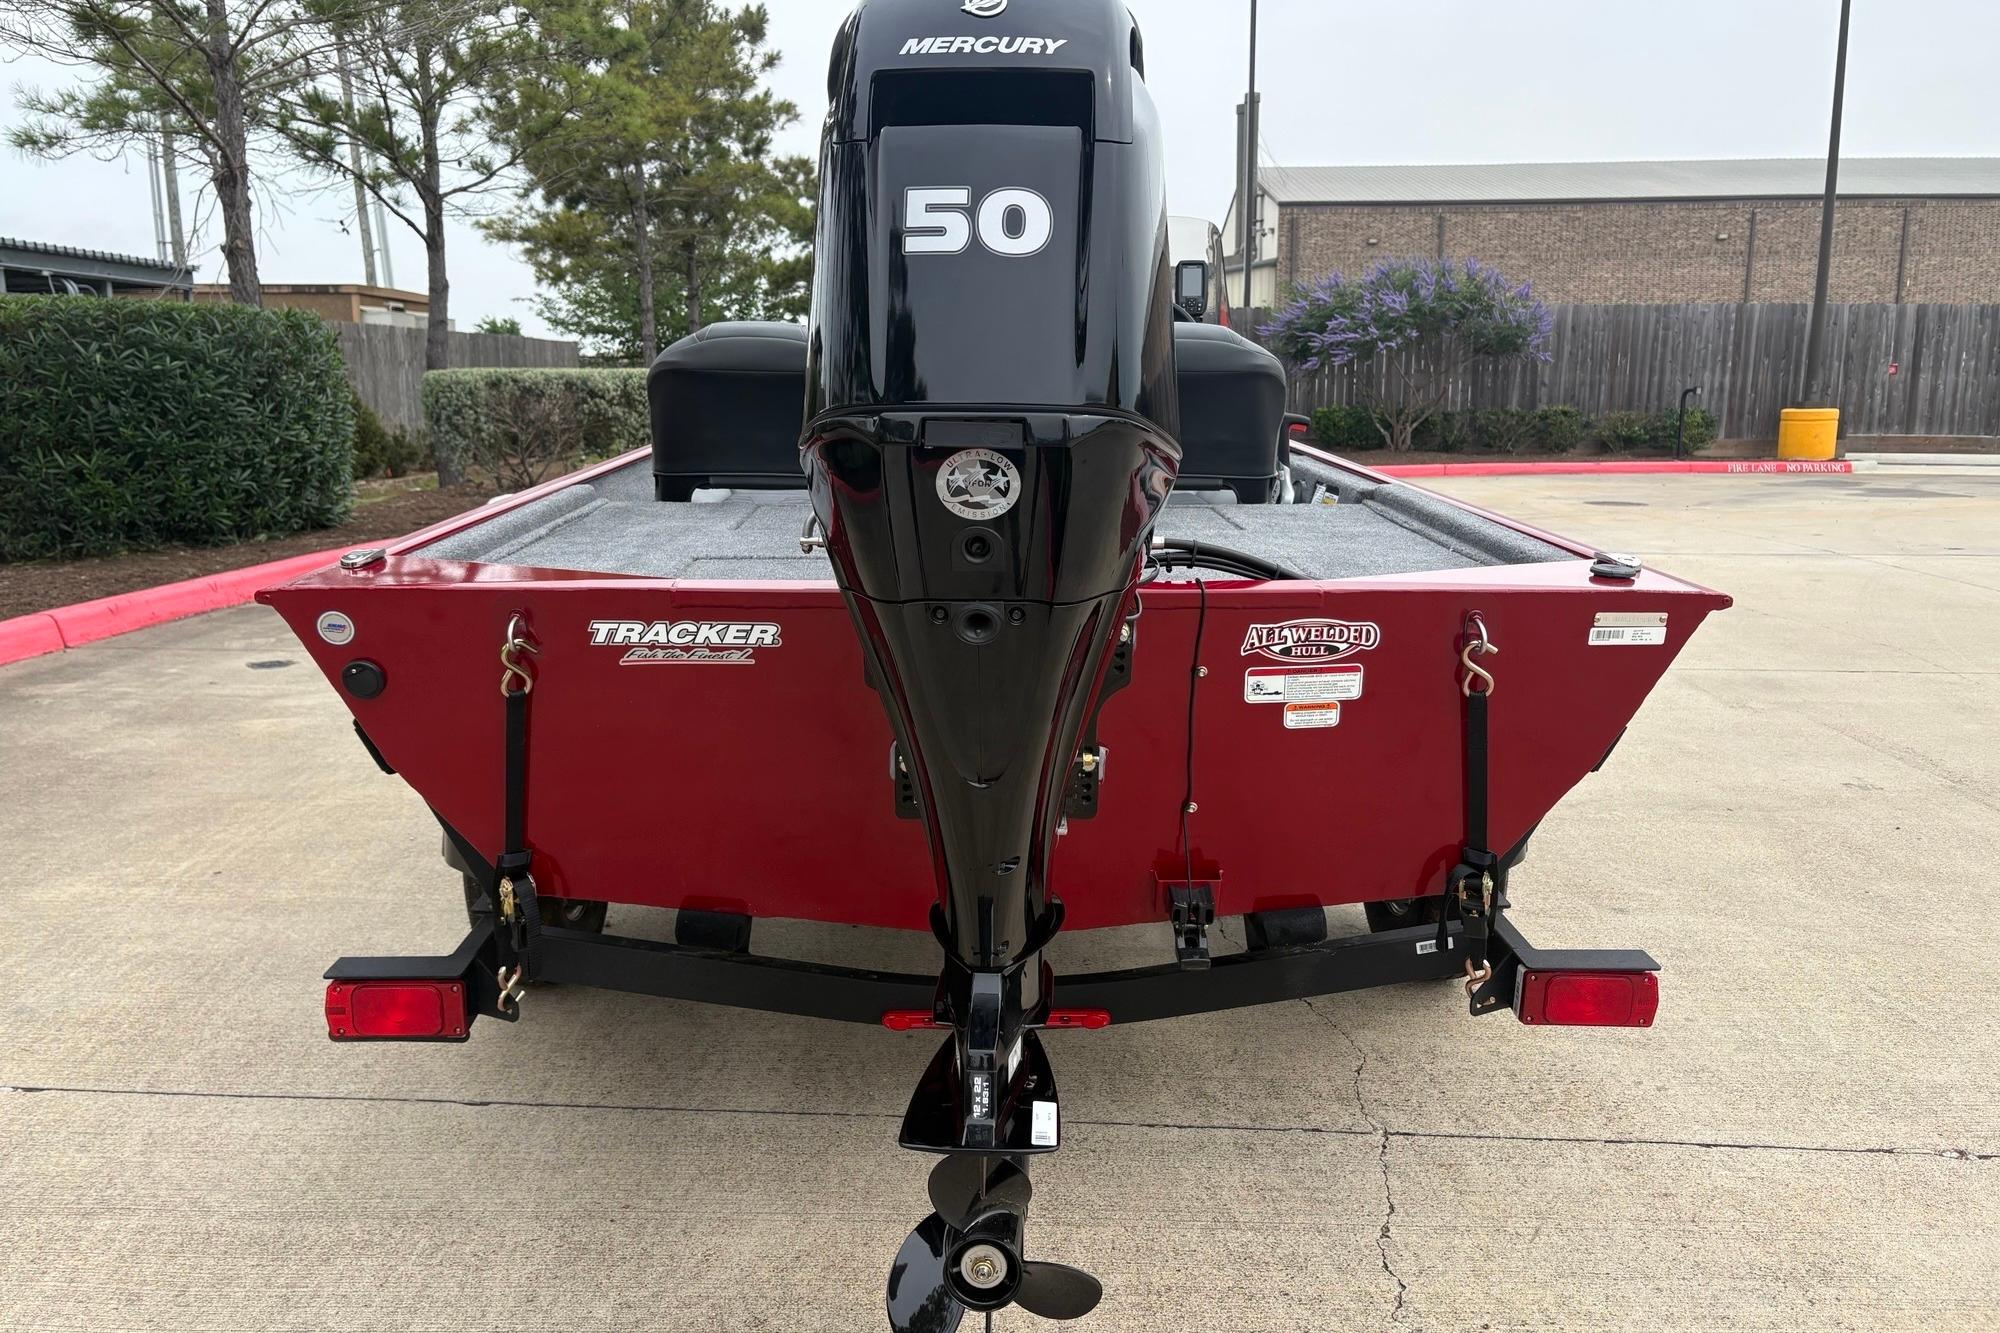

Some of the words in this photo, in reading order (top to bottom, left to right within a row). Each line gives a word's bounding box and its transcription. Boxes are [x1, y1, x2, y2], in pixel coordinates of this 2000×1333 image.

[899, 36, 1068, 55] MERCURY
[902, 186, 1054, 257] 50
[946, 451, 981, 468] ULTRA
[990, 453, 1013, 471] LOW
[1728, 463, 1749, 473] FIRE
[1751, 463, 1777, 473] LANE
[1785, 463, 1801, 473] NO
[1803, 463, 1845, 473] PARKING
[589, 621, 781, 646] TRACKER
[1244, 626, 1288, 652] ALL
[1290, 625, 1376, 646] WELDED
[626, 649, 659, 660] Fish
[662, 649, 685, 660] the
[1291, 646, 1329, 656] HULL
[973, 1076, 982, 1093] 22
[973, 1104, 982, 1118] 12
